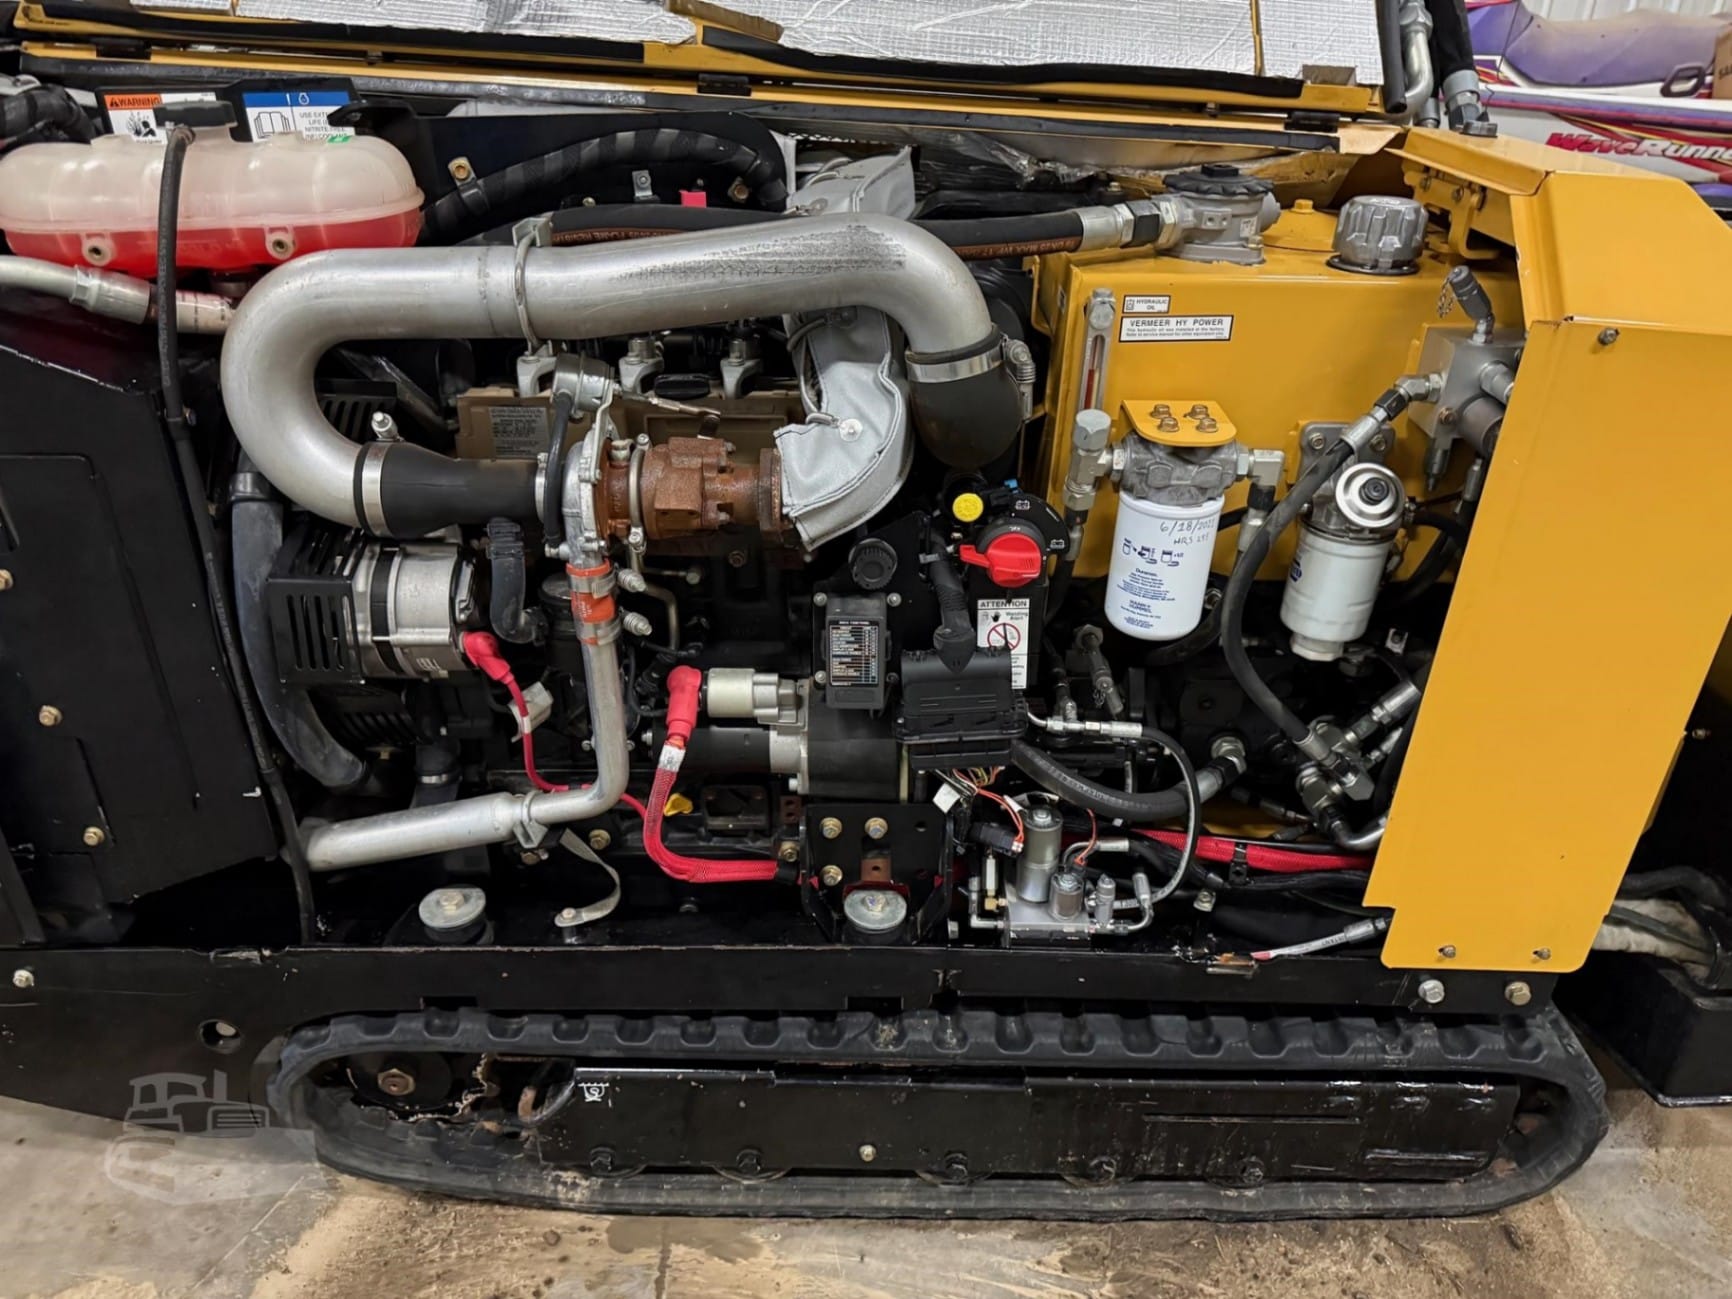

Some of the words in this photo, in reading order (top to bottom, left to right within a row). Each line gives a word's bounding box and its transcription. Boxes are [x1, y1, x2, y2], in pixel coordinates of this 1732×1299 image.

[120, 97, 160, 108] WARNING
[1545, 133, 1732, 159] WaveRunne
[1130, 319, 1171, 327] VERMEER
[1192, 318, 1224, 326] POWER
[980, 600, 1027, 608] ATTENTION
